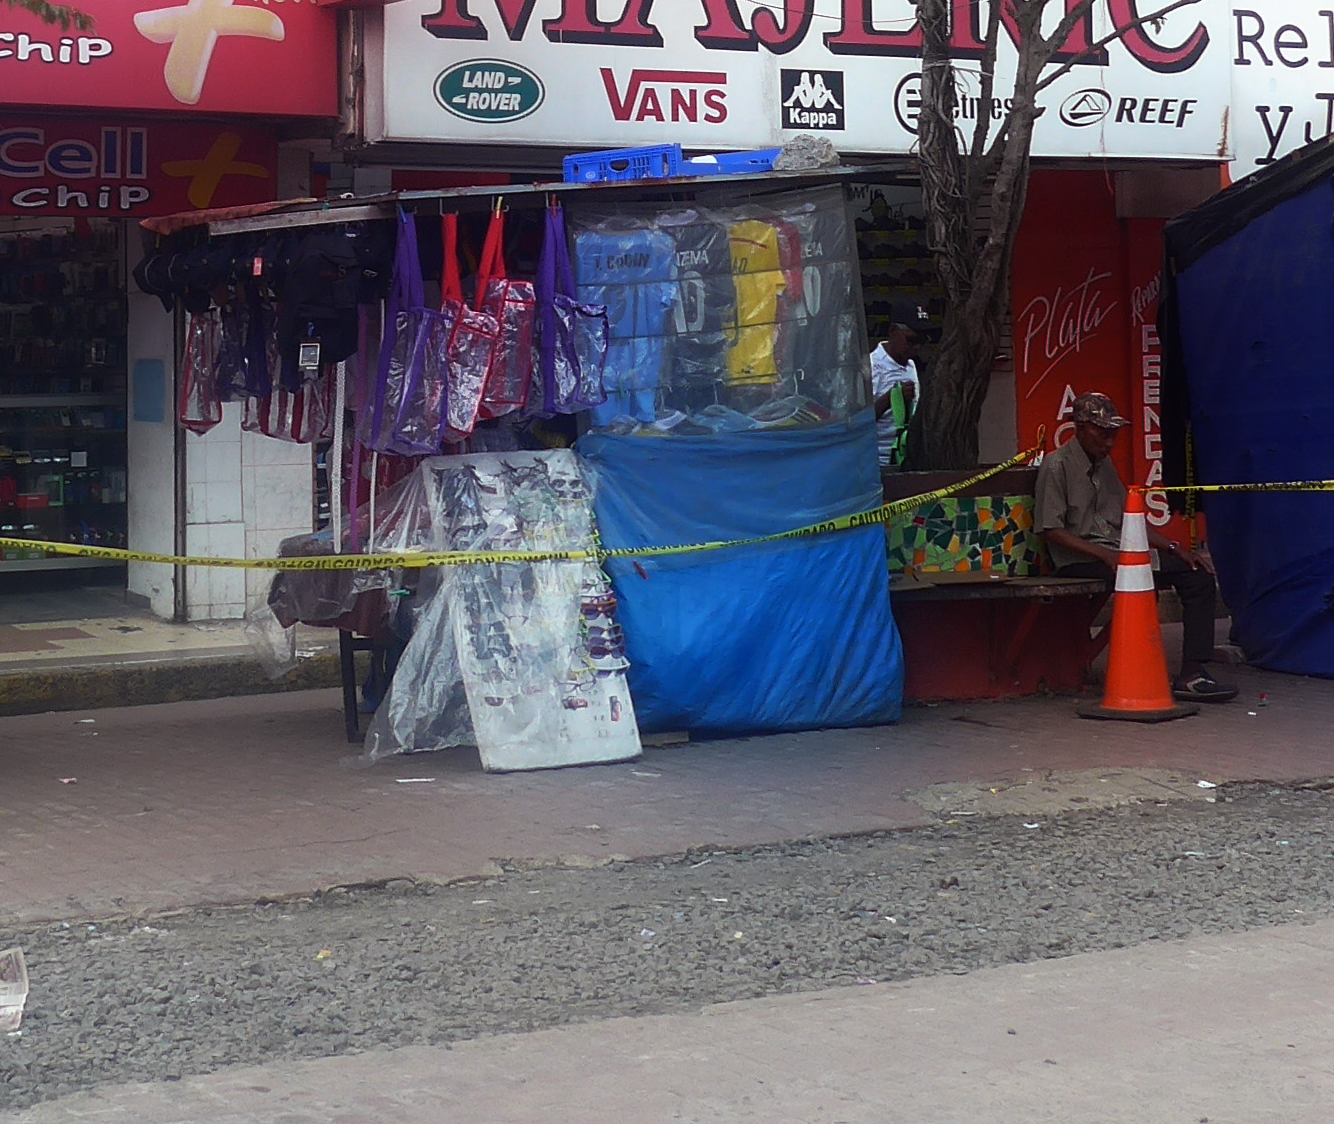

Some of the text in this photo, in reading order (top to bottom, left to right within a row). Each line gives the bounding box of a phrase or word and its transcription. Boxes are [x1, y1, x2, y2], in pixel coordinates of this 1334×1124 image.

[462, 71, 504, 88] LAND
[466, 93, 520, 111] ROVER
[1115, 97, 1198, 128] REEF
[788, 106, 837, 127] Kappa
[1018, 267, 1118, 374] Plata
